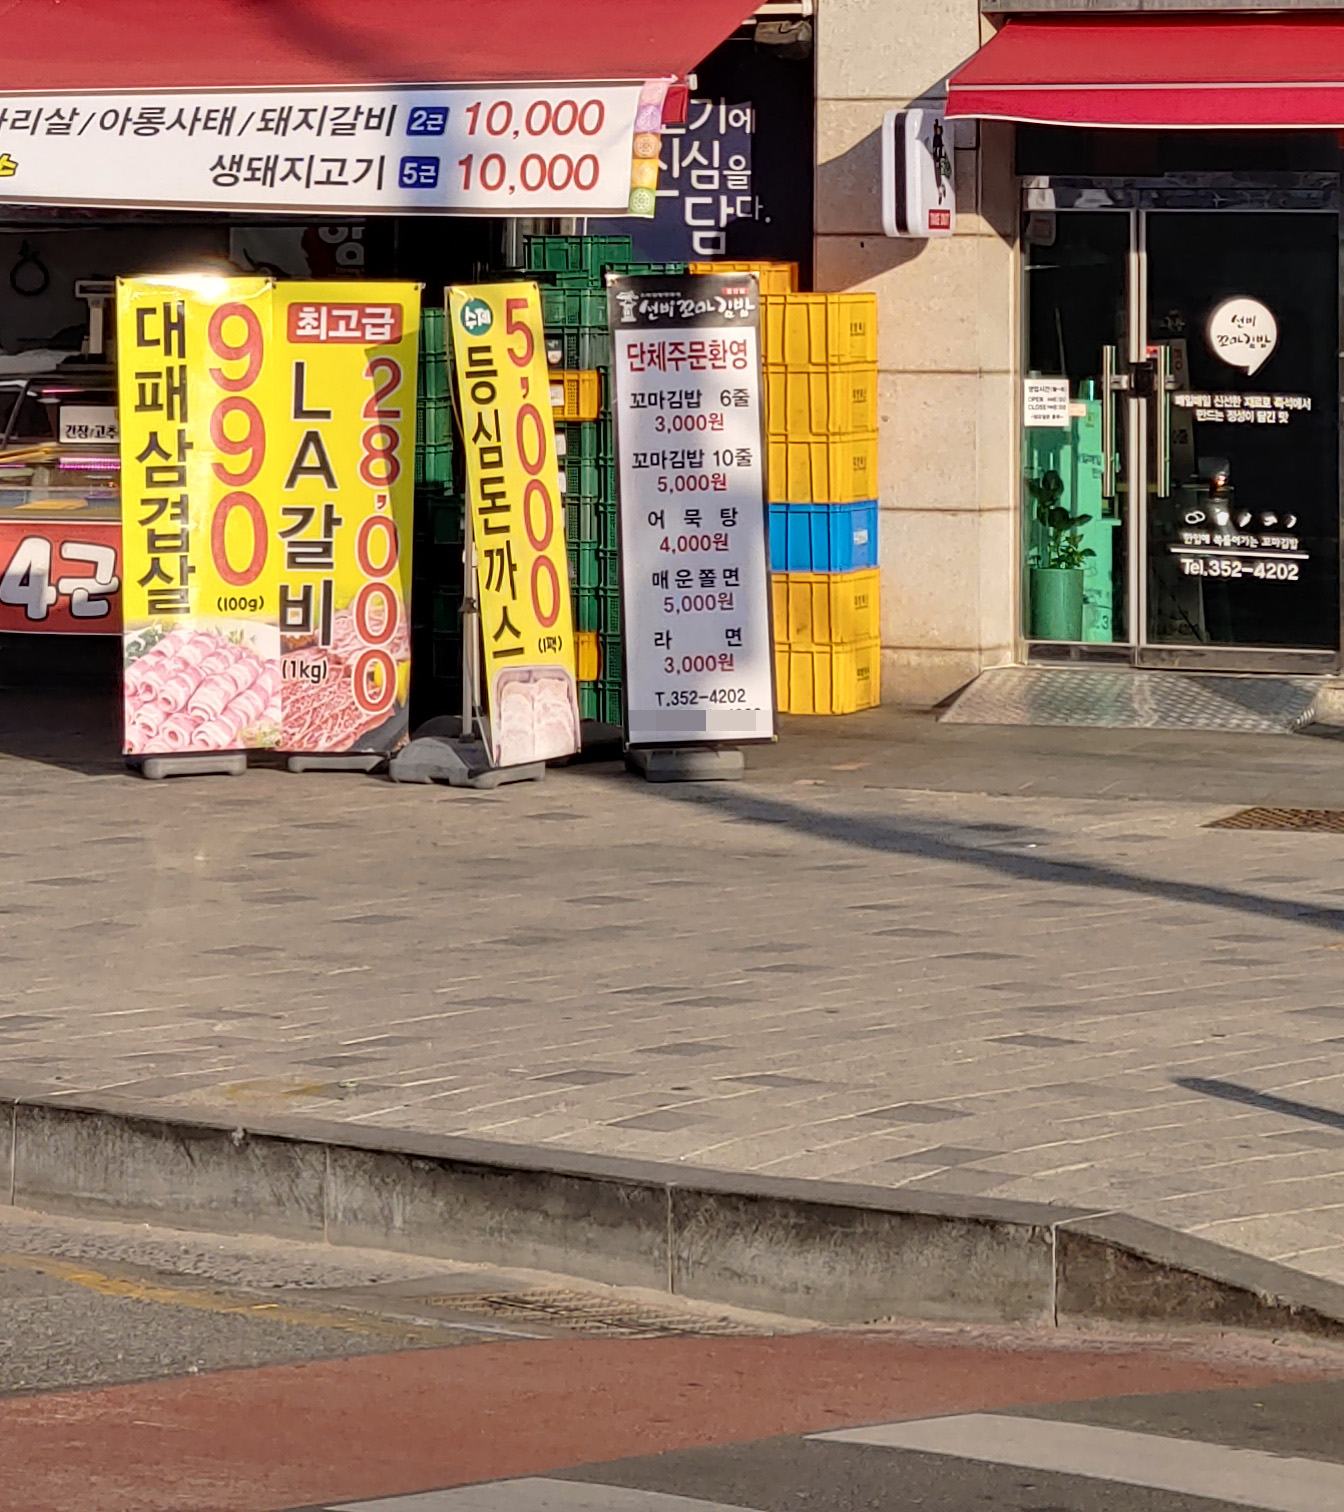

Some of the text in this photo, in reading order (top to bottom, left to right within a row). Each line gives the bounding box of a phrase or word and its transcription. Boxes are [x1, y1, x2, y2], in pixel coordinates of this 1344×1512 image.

[409, 110, 445, 133] 2근
[465, 98, 606, 139] 10,000
[208, 152, 600, 194] 생돼지고기 5근 10,000
[295, 304, 396, 344] 최고급
[626, 338, 749, 372] 단체주문환영
[629, 388, 751, 410] 꼬마김밥 6줄
[654, 412, 725, 434] 3,000원
[207, 301, 269, 588] 990
[134, 300, 197, 617] 대패삼겹살
[505, 297, 560, 629] 5,000
[631, 447, 754, 470] 꼬마김밥 10줄
[657, 472, 728, 494] 5,000원
[464, 345, 525, 659] 등심돈까스
[351, 356, 403, 714] 28,000
[659, 532, 730, 554] 4,000원
[652, 566, 741, 590] 매운쫄면
[1180, 558, 1300, 581] Tel.352-4202
[217, 594, 265, 612] (100g)
[663, 591, 735, 615] 5,000원
[281, 658, 328, 681] (1kg)
[663, 653, 735, 675] 3,000원
[654, 688, 747, 708] T.352-4202
